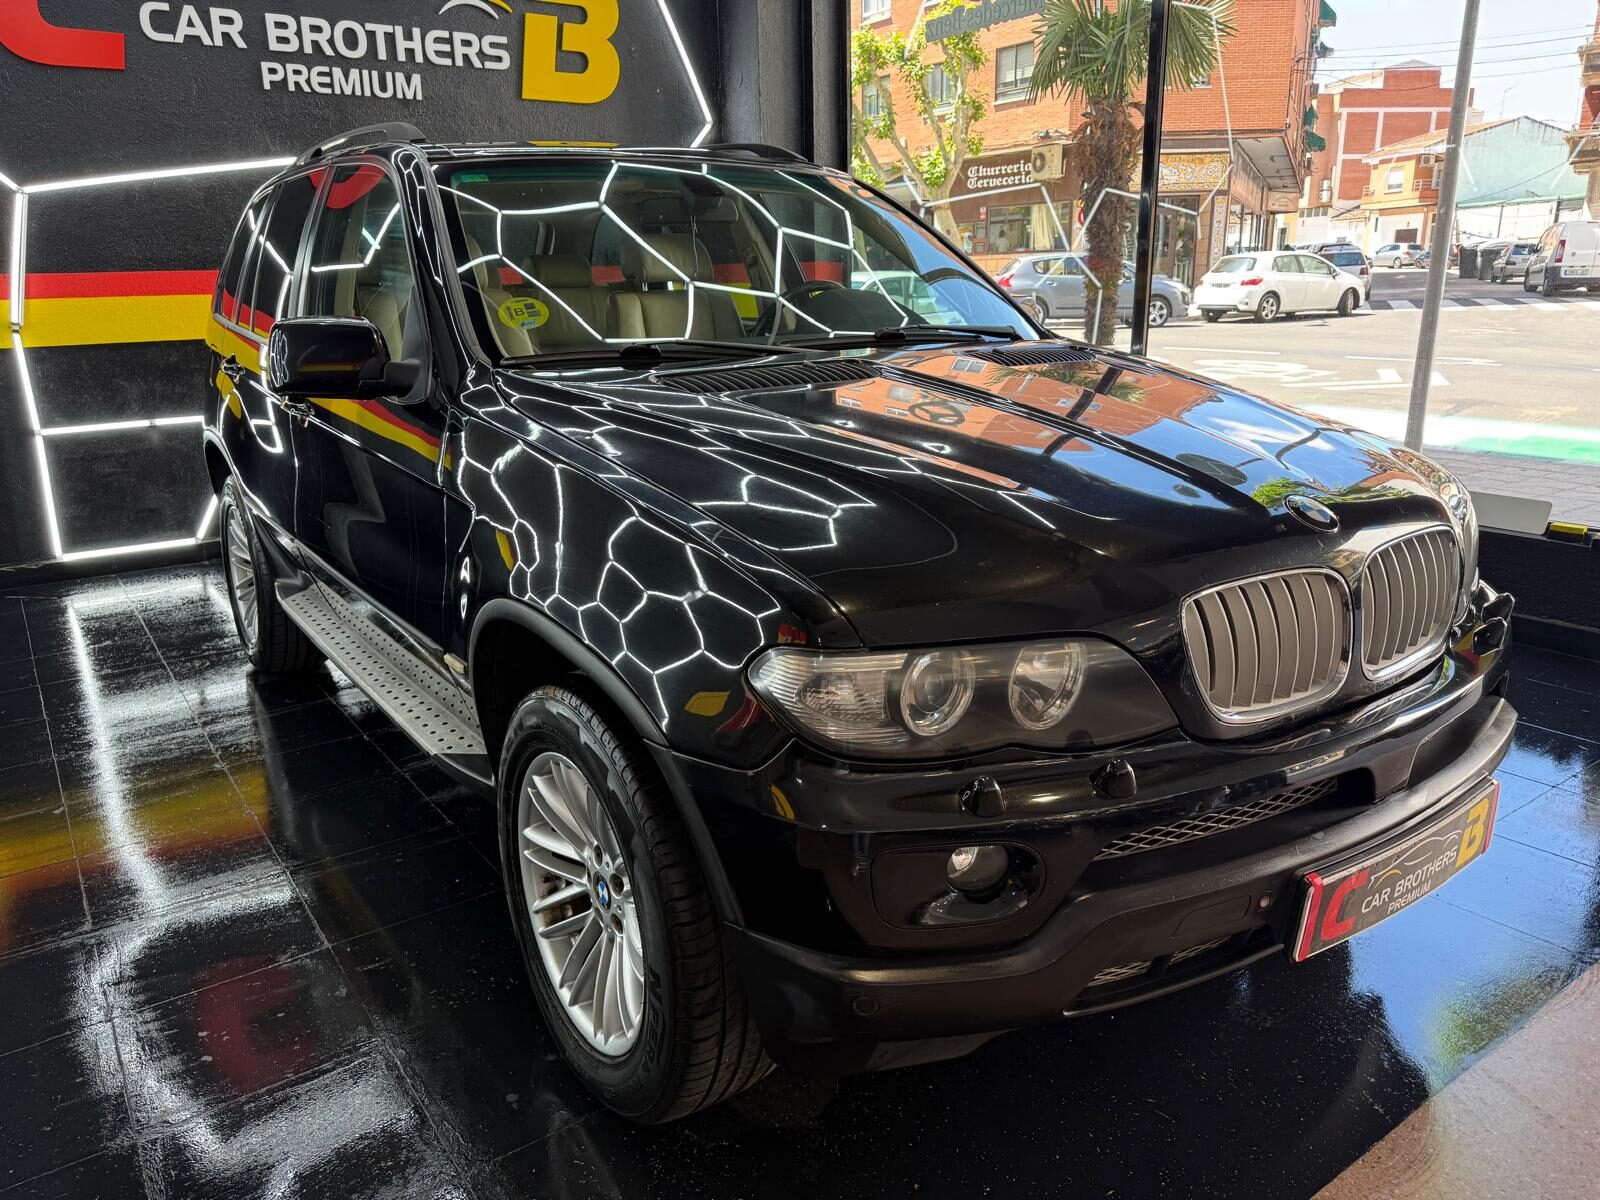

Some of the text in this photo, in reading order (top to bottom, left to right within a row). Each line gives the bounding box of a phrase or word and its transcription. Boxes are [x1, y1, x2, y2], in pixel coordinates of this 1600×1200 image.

[139, 1, 248, 49] CAR
[264, 12, 511, 71] BROTHERS
[260, 61, 423, 101] PREMIUM
[1455, 798, 1489, 868] B
[1321, 868, 1370, 941] C
[1361, 844, 1458, 914] CAR BROTHERS
[1387, 880, 1432, 915] PREMIUM
